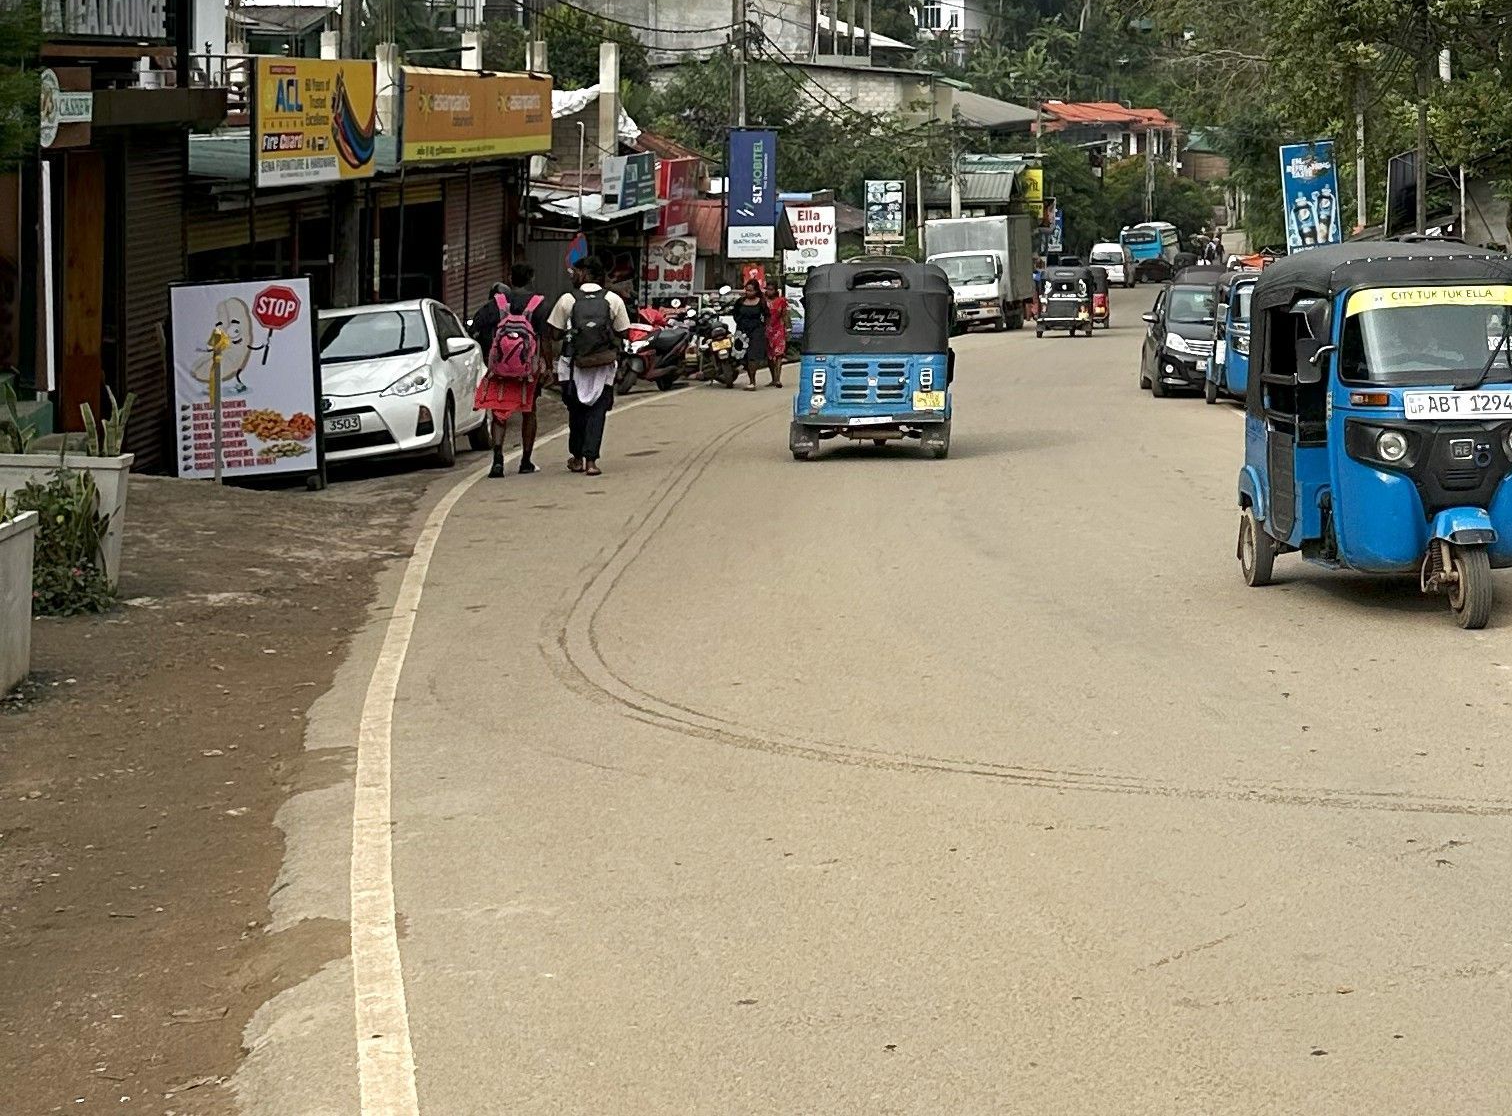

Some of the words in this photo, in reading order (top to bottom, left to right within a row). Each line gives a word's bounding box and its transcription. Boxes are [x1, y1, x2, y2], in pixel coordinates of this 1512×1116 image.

[275, 78, 303, 113] ACL
[797, 210, 820, 222] Ella
[790, 222, 833, 236] aundry
[1392, 291, 1413, 300] CITY
[1418, 290, 1437, 300] TUK
[1442, 289, 1462, 299] TUK
[1466, 288, 1493, 298] ELLA
[257, 296, 297, 318] STOP
[1411, 405, 1425, 415] UP
[1428, 395, 1462, 414] ABT
[329, 417, 359, 431] 3503
